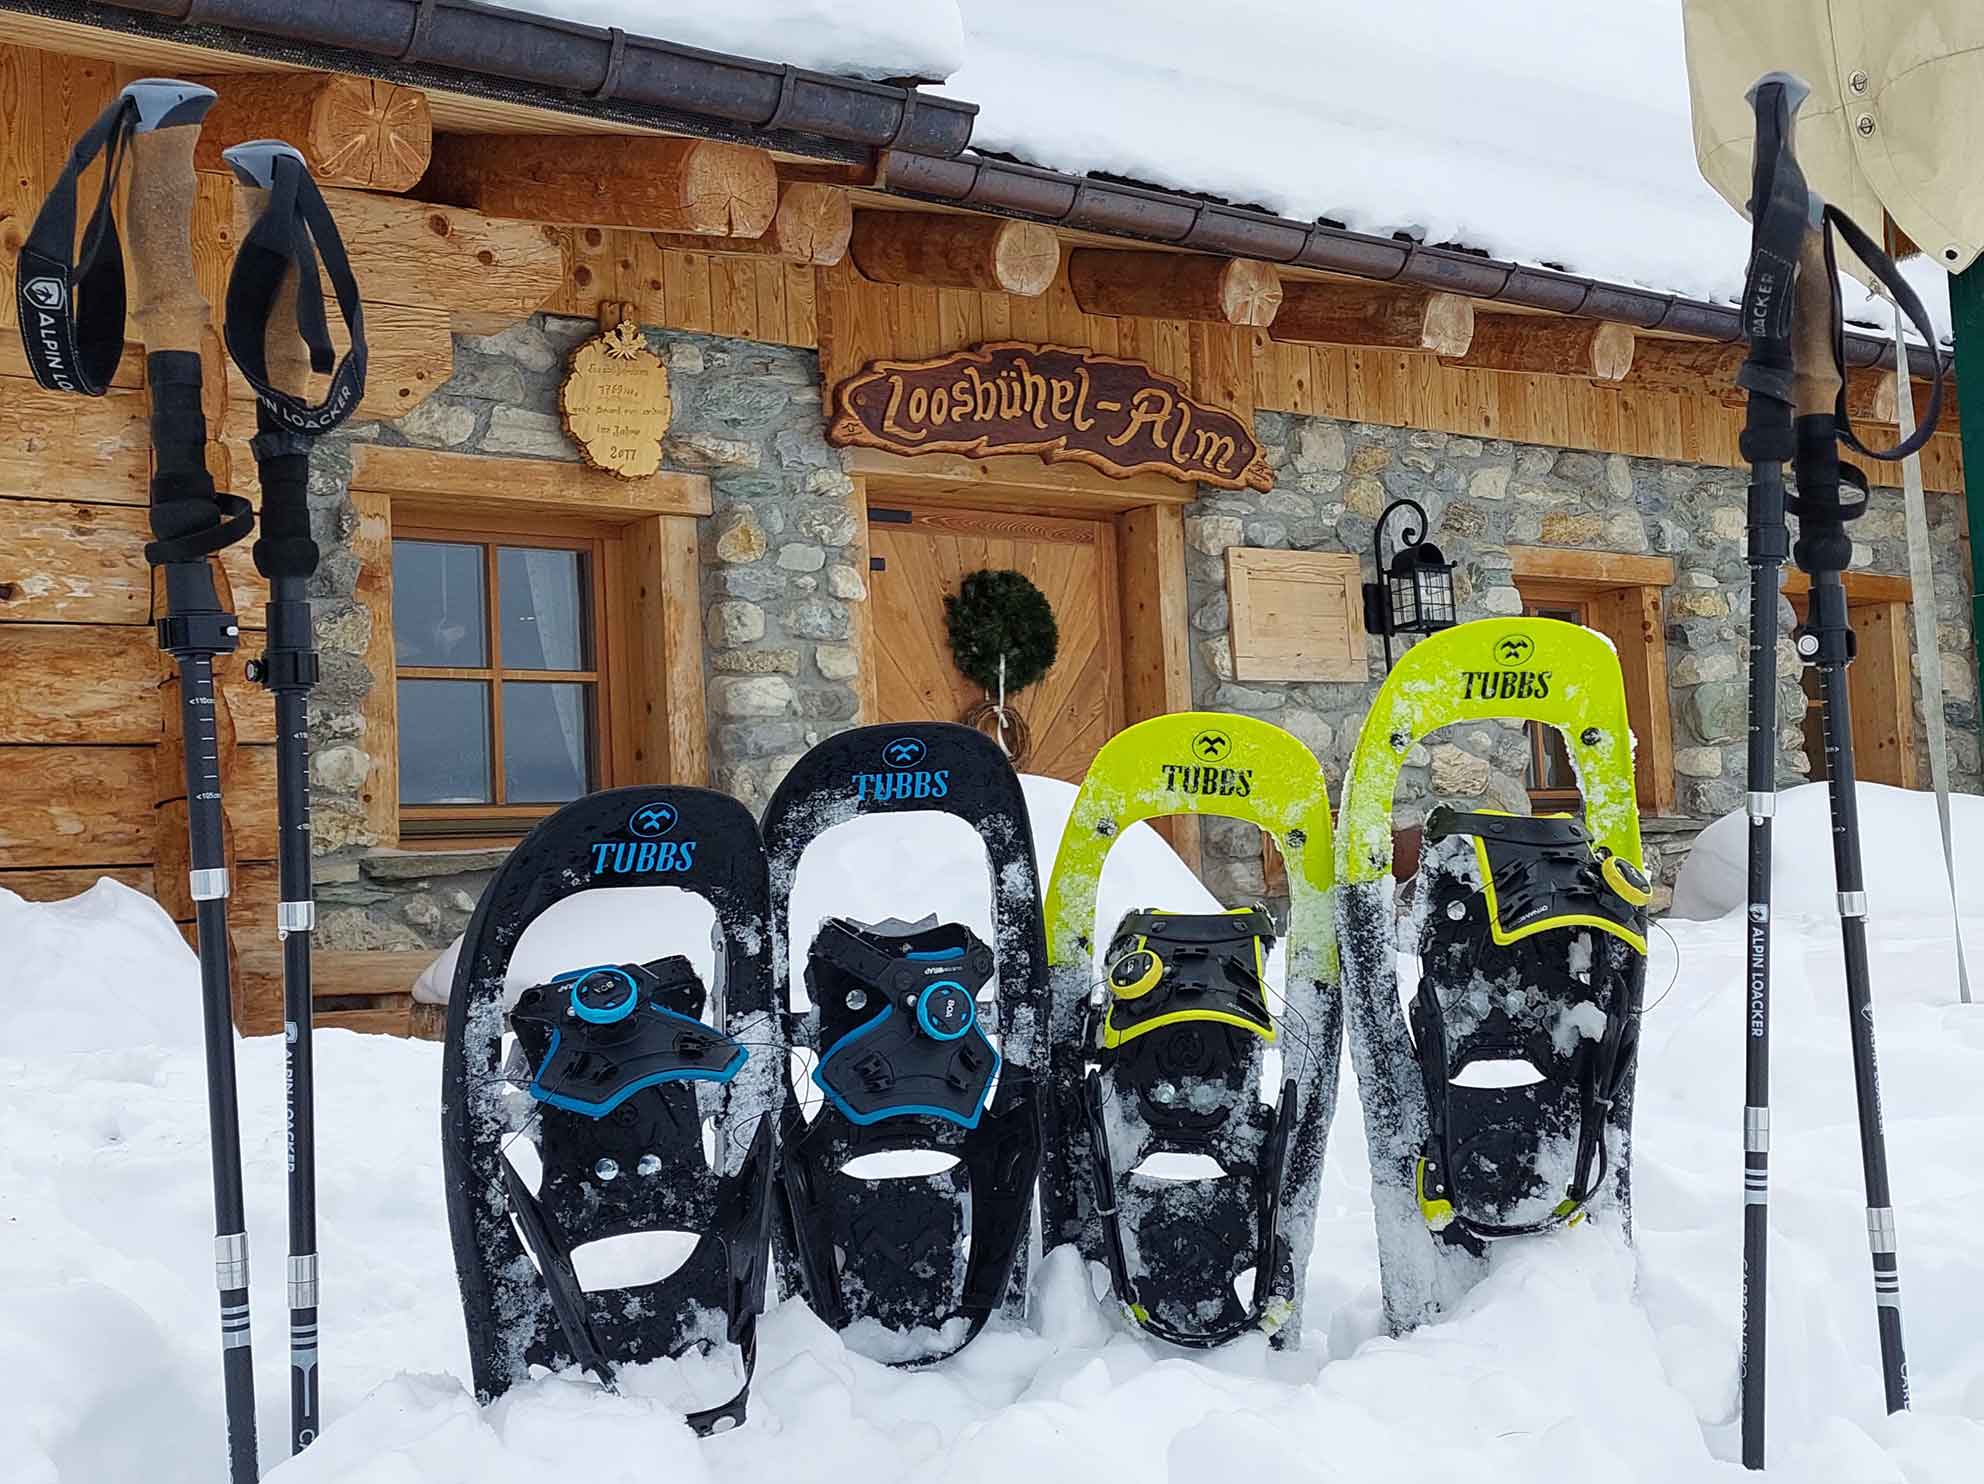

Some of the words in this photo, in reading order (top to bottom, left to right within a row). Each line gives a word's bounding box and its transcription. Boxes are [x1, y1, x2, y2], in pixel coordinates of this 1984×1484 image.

[38, 311, 64, 369] ALPIN
[282, 385, 352, 429] LOACKER
[1462, 671, 1553, 699] TUBBS
[851, 770, 951, 801] TUBBS
[1161, 764, 1254, 798] TUBBS
[592, 841, 697, 875] TUBBS
[1751, 927, 1765, 969] ALPIN
[1751, 972, 1765, 1038] LOACKER
